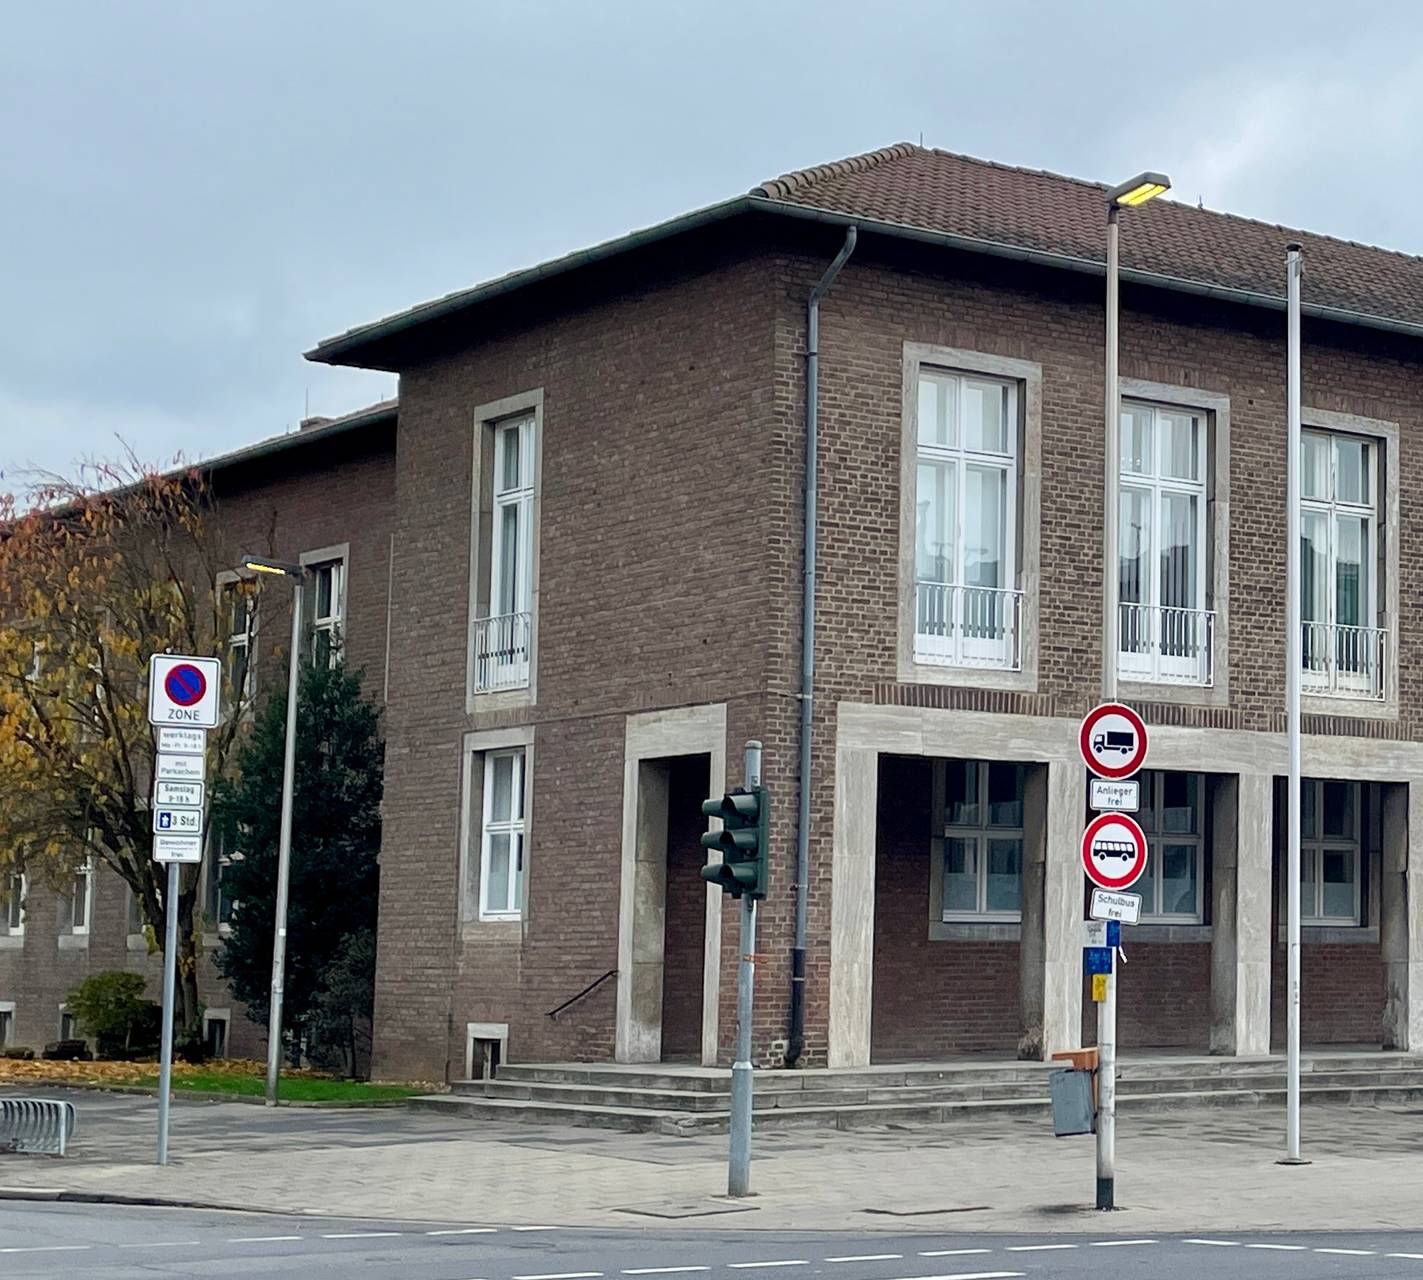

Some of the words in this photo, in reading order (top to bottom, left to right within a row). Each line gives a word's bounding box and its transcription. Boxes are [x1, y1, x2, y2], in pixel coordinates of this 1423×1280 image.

[168, 708, 200, 720] ZONE
[165, 784, 194, 794] Samstag
[1097, 786, 1133, 797] Anlieger
[1108, 797, 1122, 806] frei
[172, 815, 177, 826] 3
[1098, 894, 1135, 907] Schulbus
[1109, 908, 1122, 918] frei
